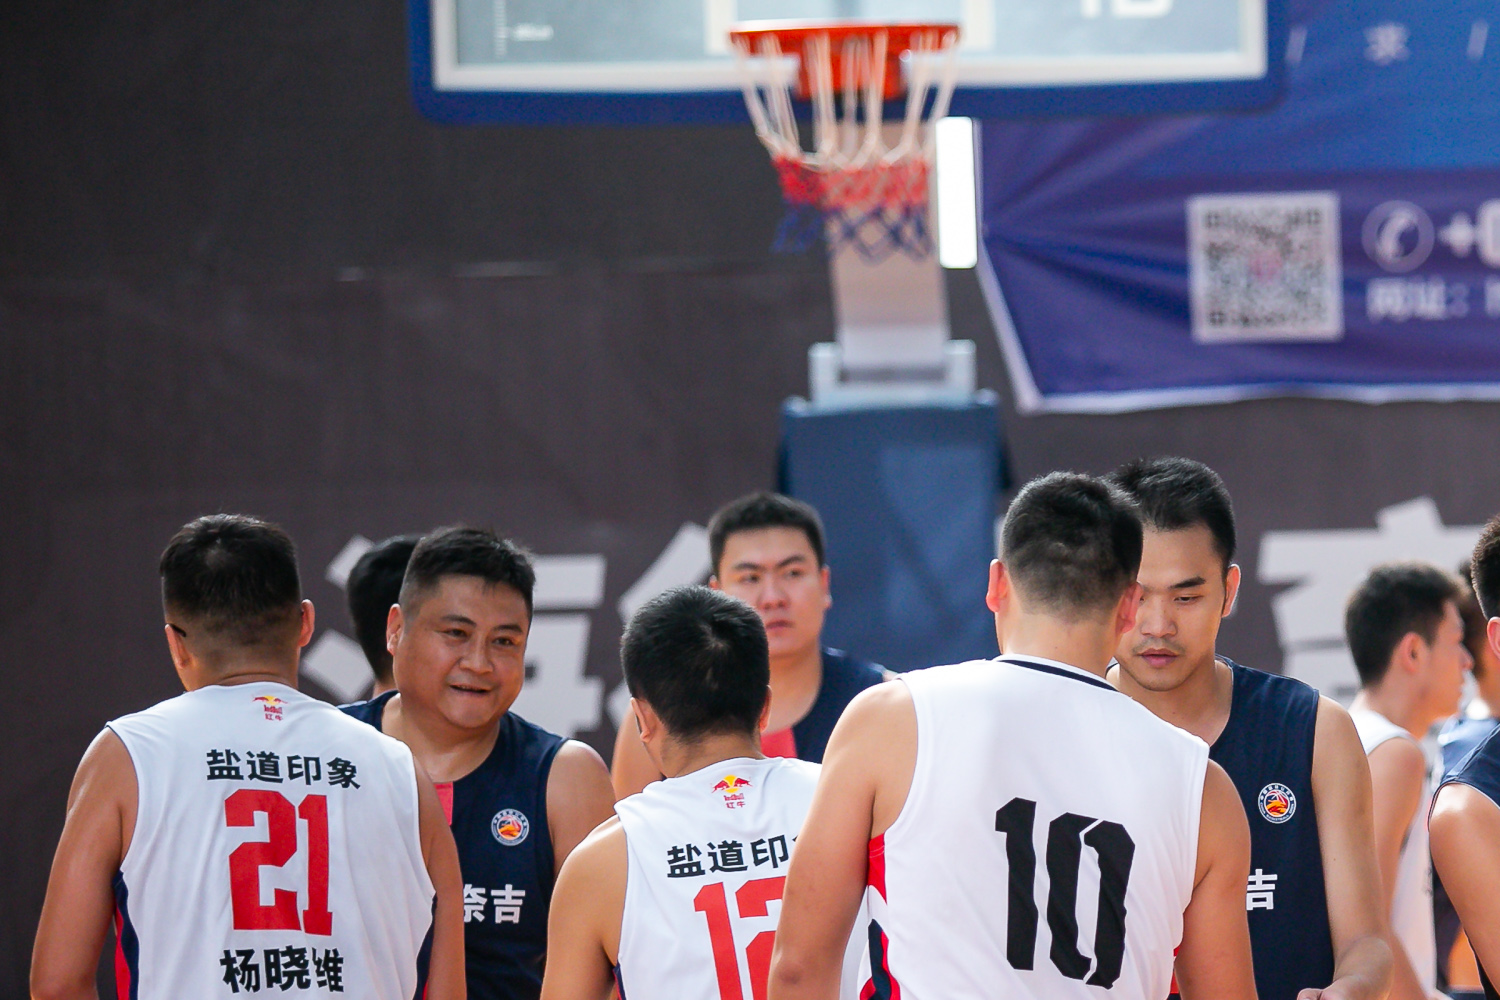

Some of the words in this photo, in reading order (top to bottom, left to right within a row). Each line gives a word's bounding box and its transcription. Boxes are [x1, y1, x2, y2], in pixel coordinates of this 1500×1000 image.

[205, 748, 361, 790] 盐道印象
[224, 788, 333, 936] 21
[667, 834, 800, 878] 盐道印
[995, 797, 1135, 990] 10
[219, 945, 344, 993] 杨晓维
